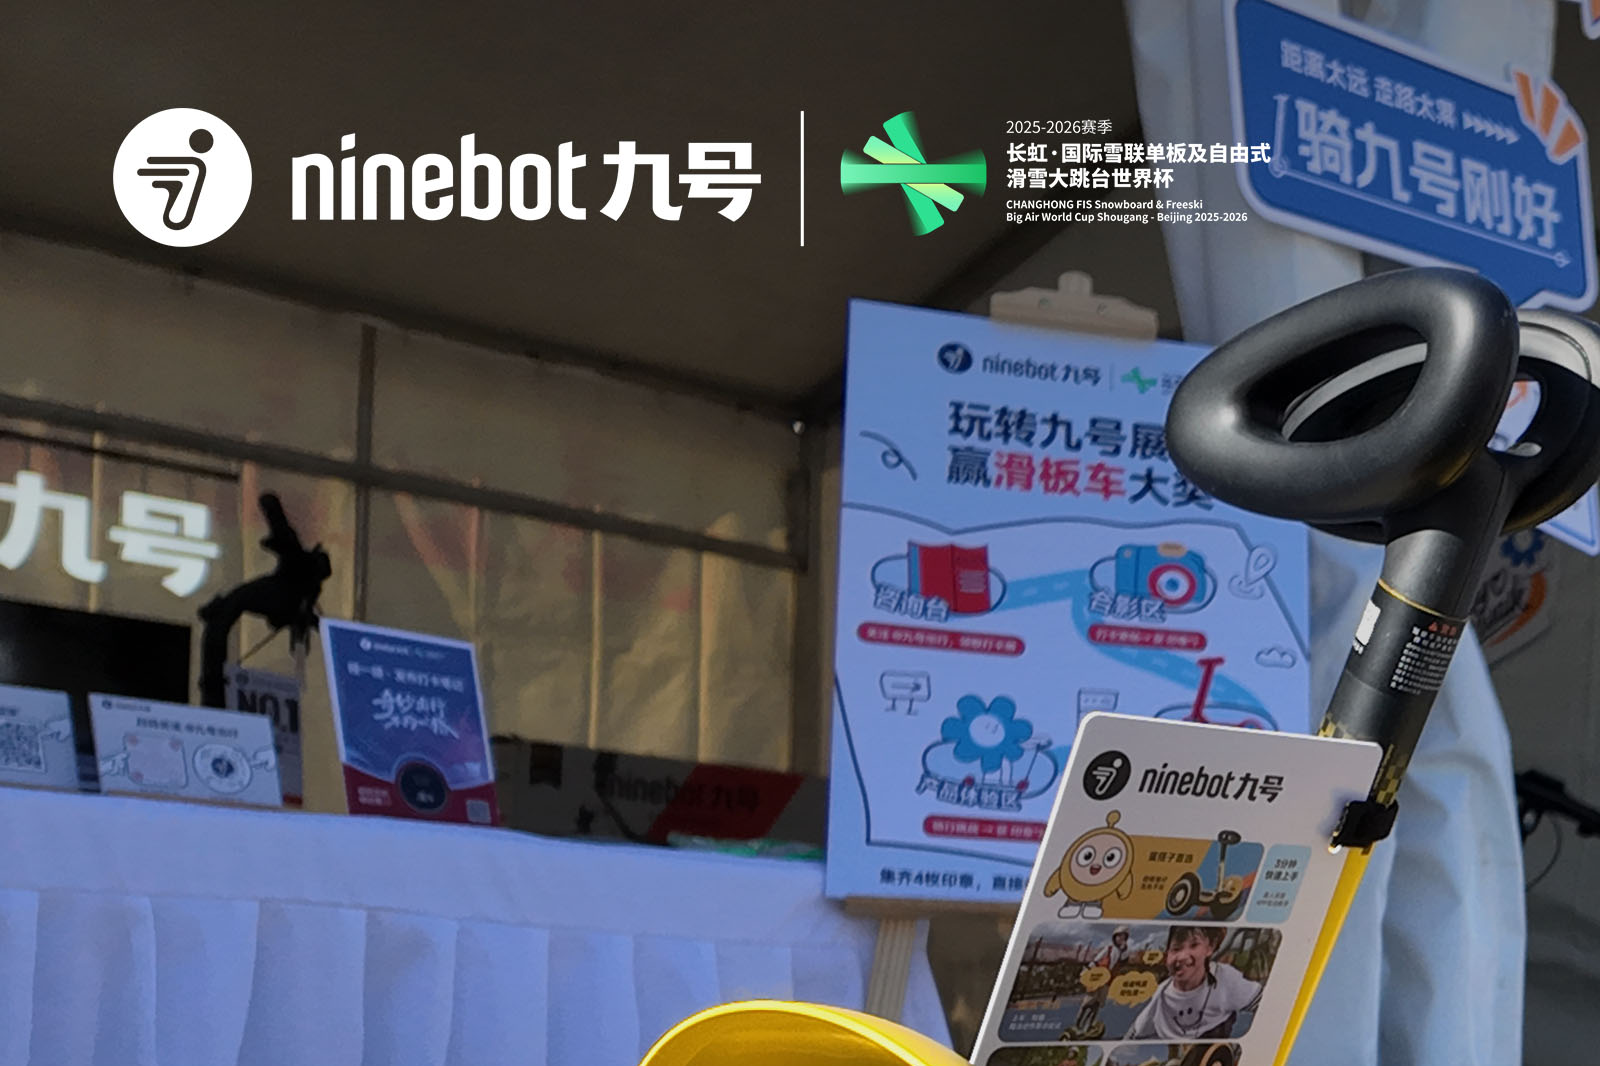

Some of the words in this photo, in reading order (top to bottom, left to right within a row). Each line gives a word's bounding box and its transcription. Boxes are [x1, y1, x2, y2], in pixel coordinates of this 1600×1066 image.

[1280, 40, 1371, 99] 距离太远
[1296, 99, 1562, 249] 骑九号刚好
[982, 353, 1059, 382] ninebot
[1062, 364, 1101, 386] 九号
[946, 445, 1216, 511] 赢滑板车大奖
[0, 470, 220, 598] 九号
[916, 773, 1023, 812] 产品体验区
[1138, 762, 1234, 800] ninebot
[1233, 773, 1285, 803] 九号
[880, 867, 1030, 893] 集齐4枚印章，直接
[1265, 870, 1299, 882] 快速上手
[1274, 858, 1298, 869] 3分钟
